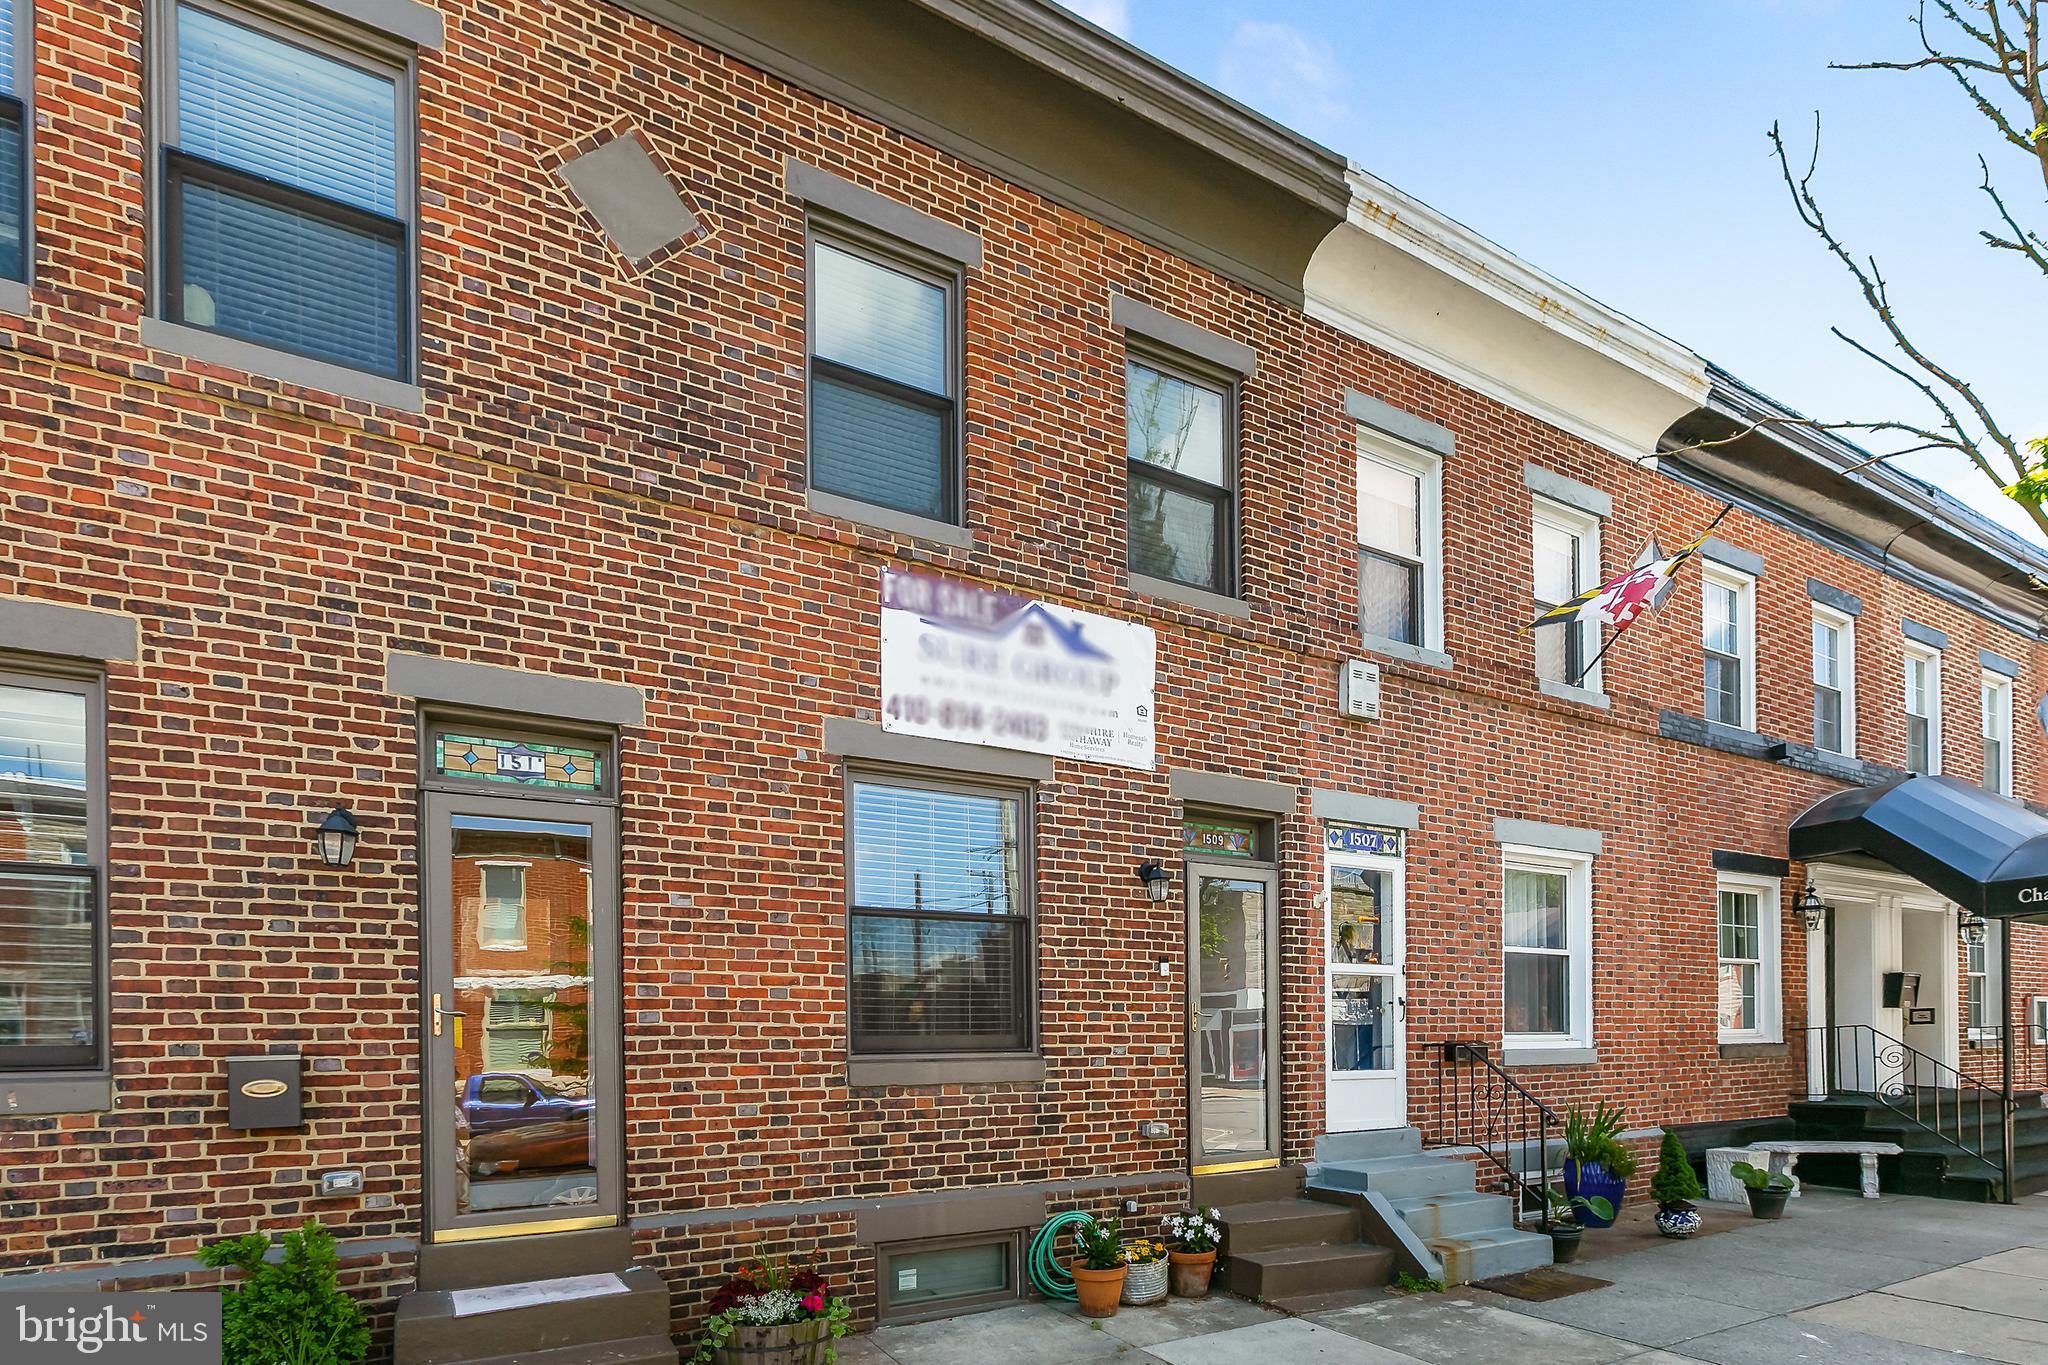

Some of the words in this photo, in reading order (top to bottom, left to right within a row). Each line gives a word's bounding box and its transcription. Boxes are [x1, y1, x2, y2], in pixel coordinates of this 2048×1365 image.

[501, 754, 542, 770] 151
[1202, 833, 1224, 846] 1509
[1350, 832, 1377, 848] 1507
